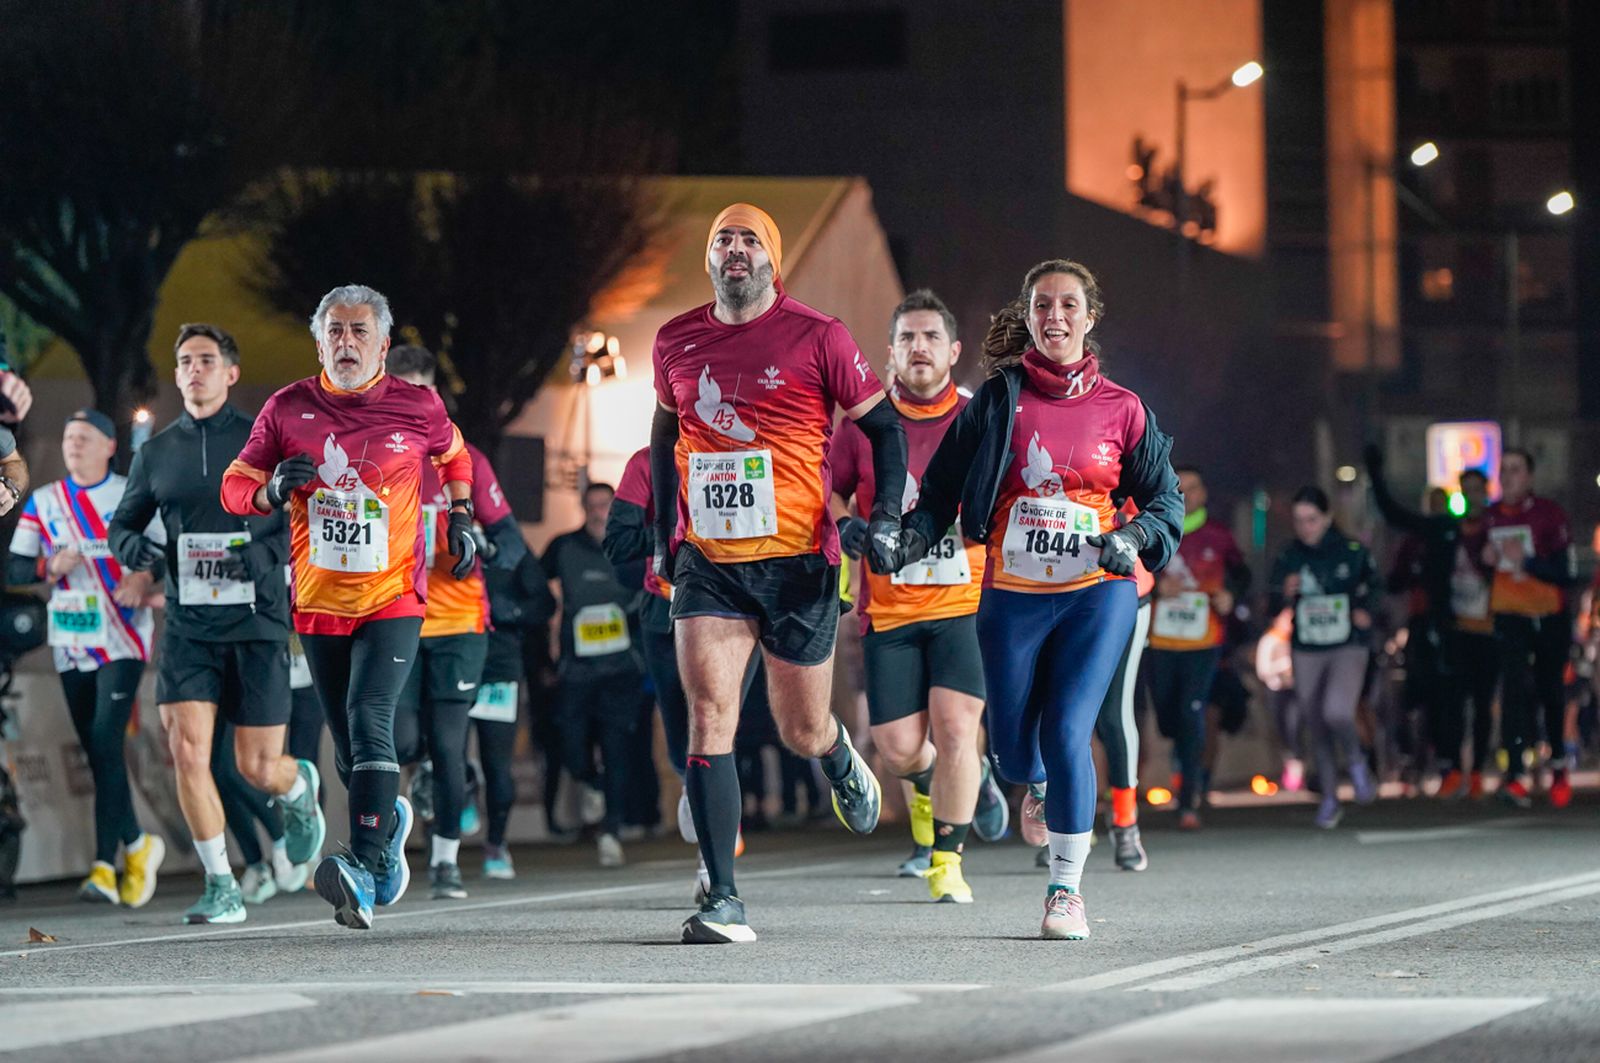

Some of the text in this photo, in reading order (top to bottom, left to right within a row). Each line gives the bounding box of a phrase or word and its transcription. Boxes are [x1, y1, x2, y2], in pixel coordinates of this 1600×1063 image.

[712, 408, 736, 431] 43
[725, 462, 736, 471] DE
[335, 473, 358, 491] 43
[1039, 479, 1061, 497] 43
[702, 482, 755, 509] 1328
[316, 506, 332, 517] SAN
[1029, 507, 1054, 518] NOCHE
[1055, 510, 1067, 519] DE
[1018, 516, 1036, 527] SAN
[322, 518, 372, 545] 5321
[926, 538, 955, 560] 43
[1025, 529, 1081, 558] 1844
[194, 560, 232, 580] 474
